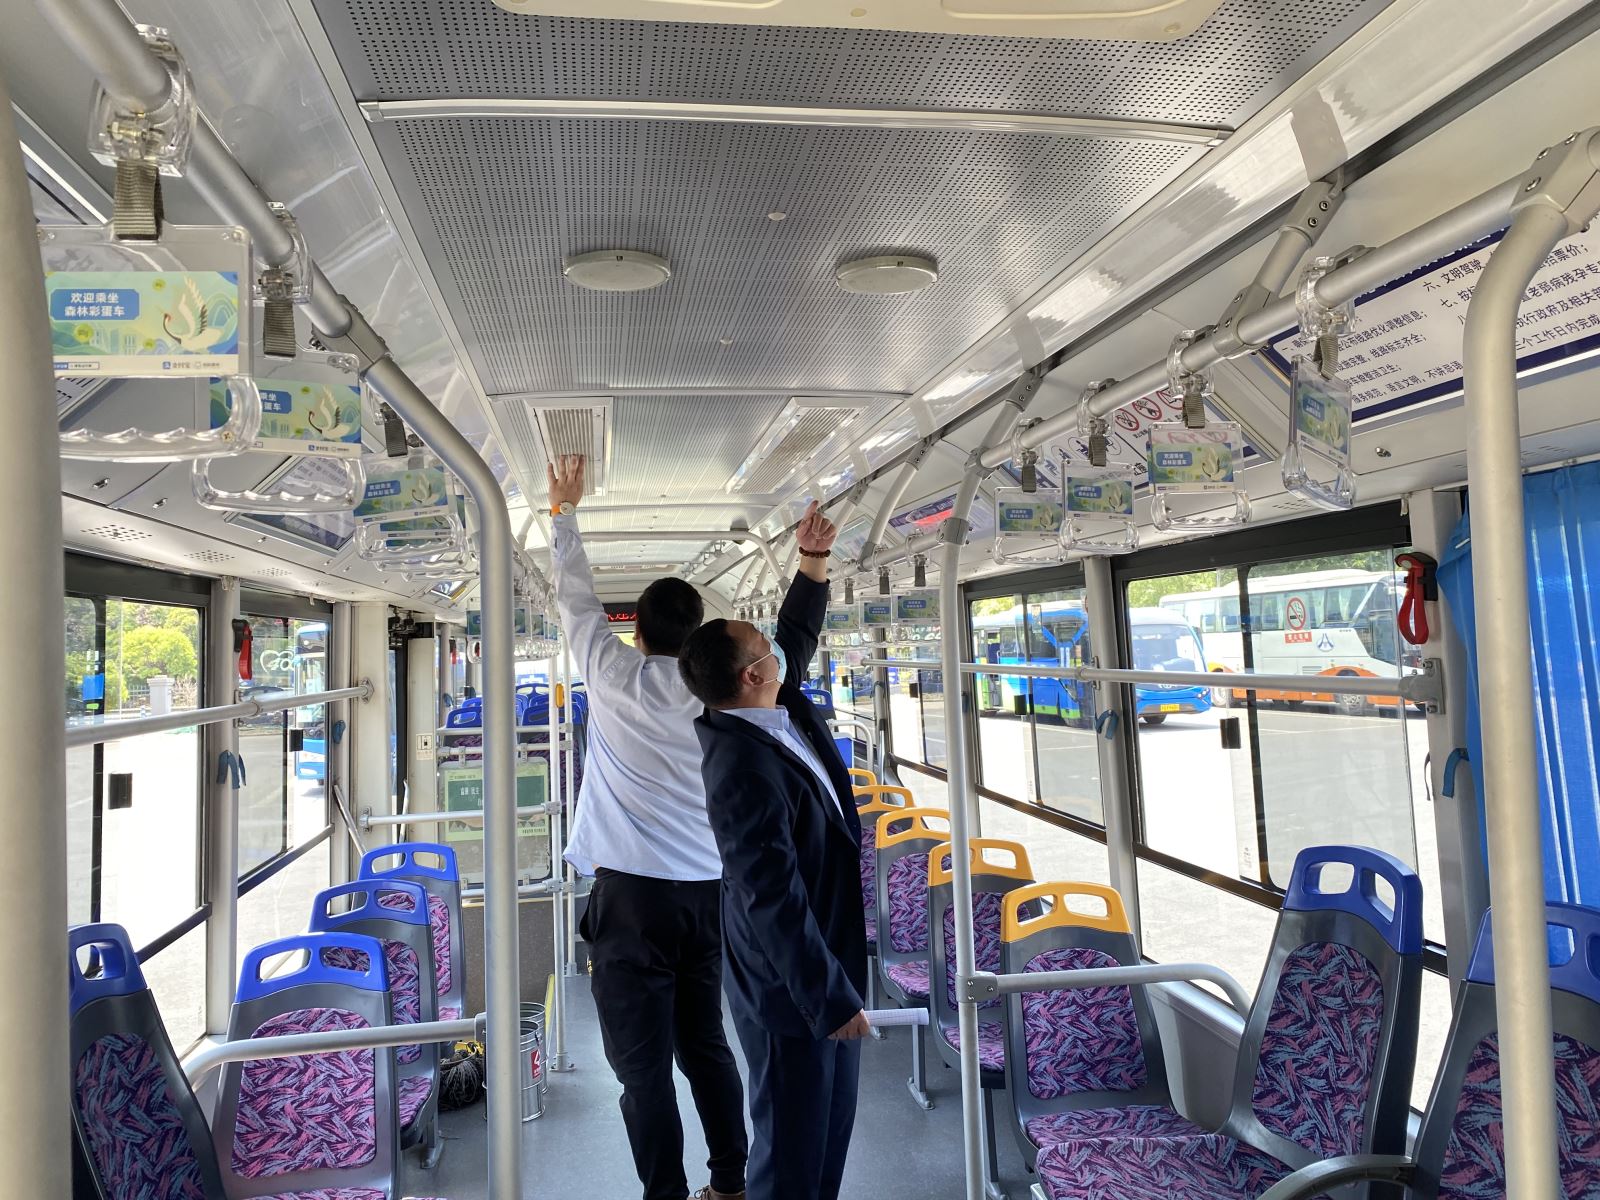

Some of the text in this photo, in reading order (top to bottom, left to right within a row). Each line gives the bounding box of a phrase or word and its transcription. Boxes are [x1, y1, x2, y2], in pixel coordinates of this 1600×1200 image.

[71, 292, 119, 303] 欢迎乘坐
[64, 306, 125, 317] 森林彩蛋车
